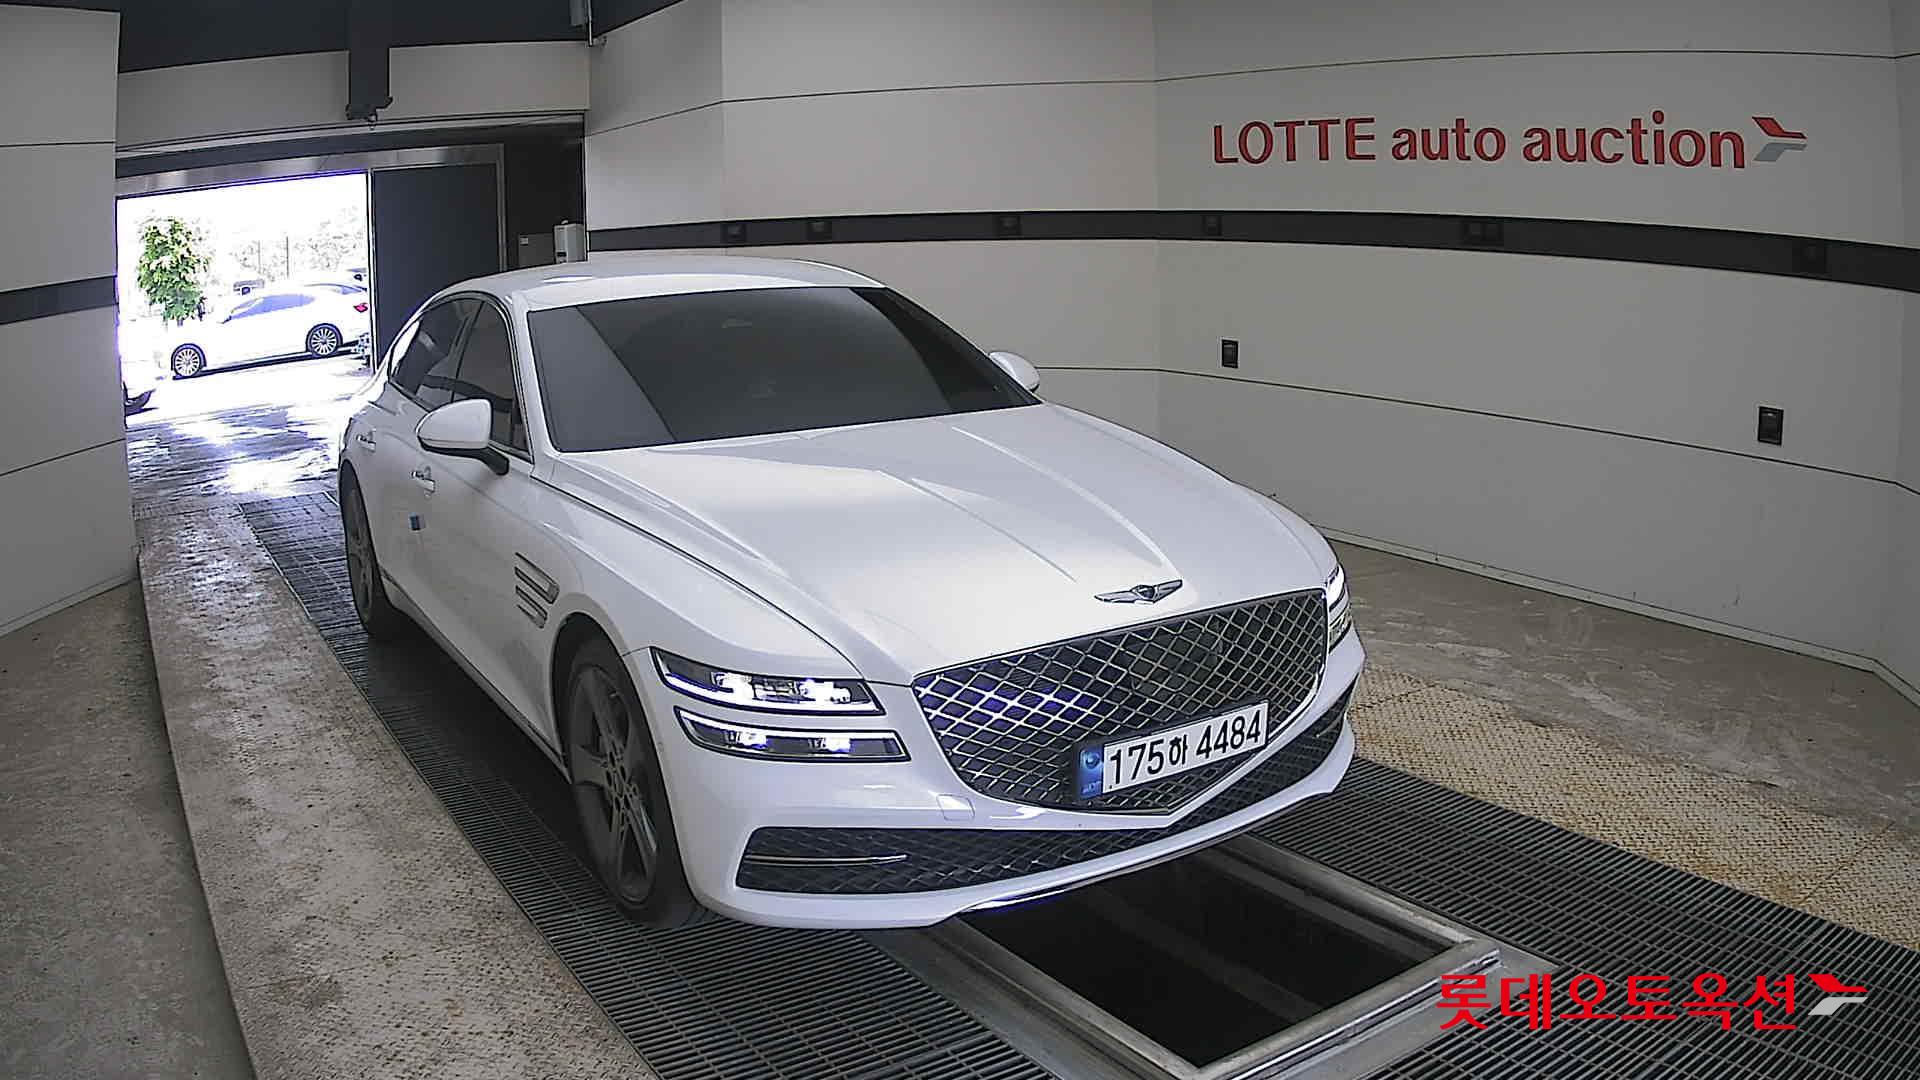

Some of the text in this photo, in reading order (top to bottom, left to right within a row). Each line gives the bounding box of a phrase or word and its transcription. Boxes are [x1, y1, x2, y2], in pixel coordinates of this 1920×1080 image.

[1213, 110, 1745, 168] LOTTE auto auction
[1110, 710, 1261, 785] 175하 4484
